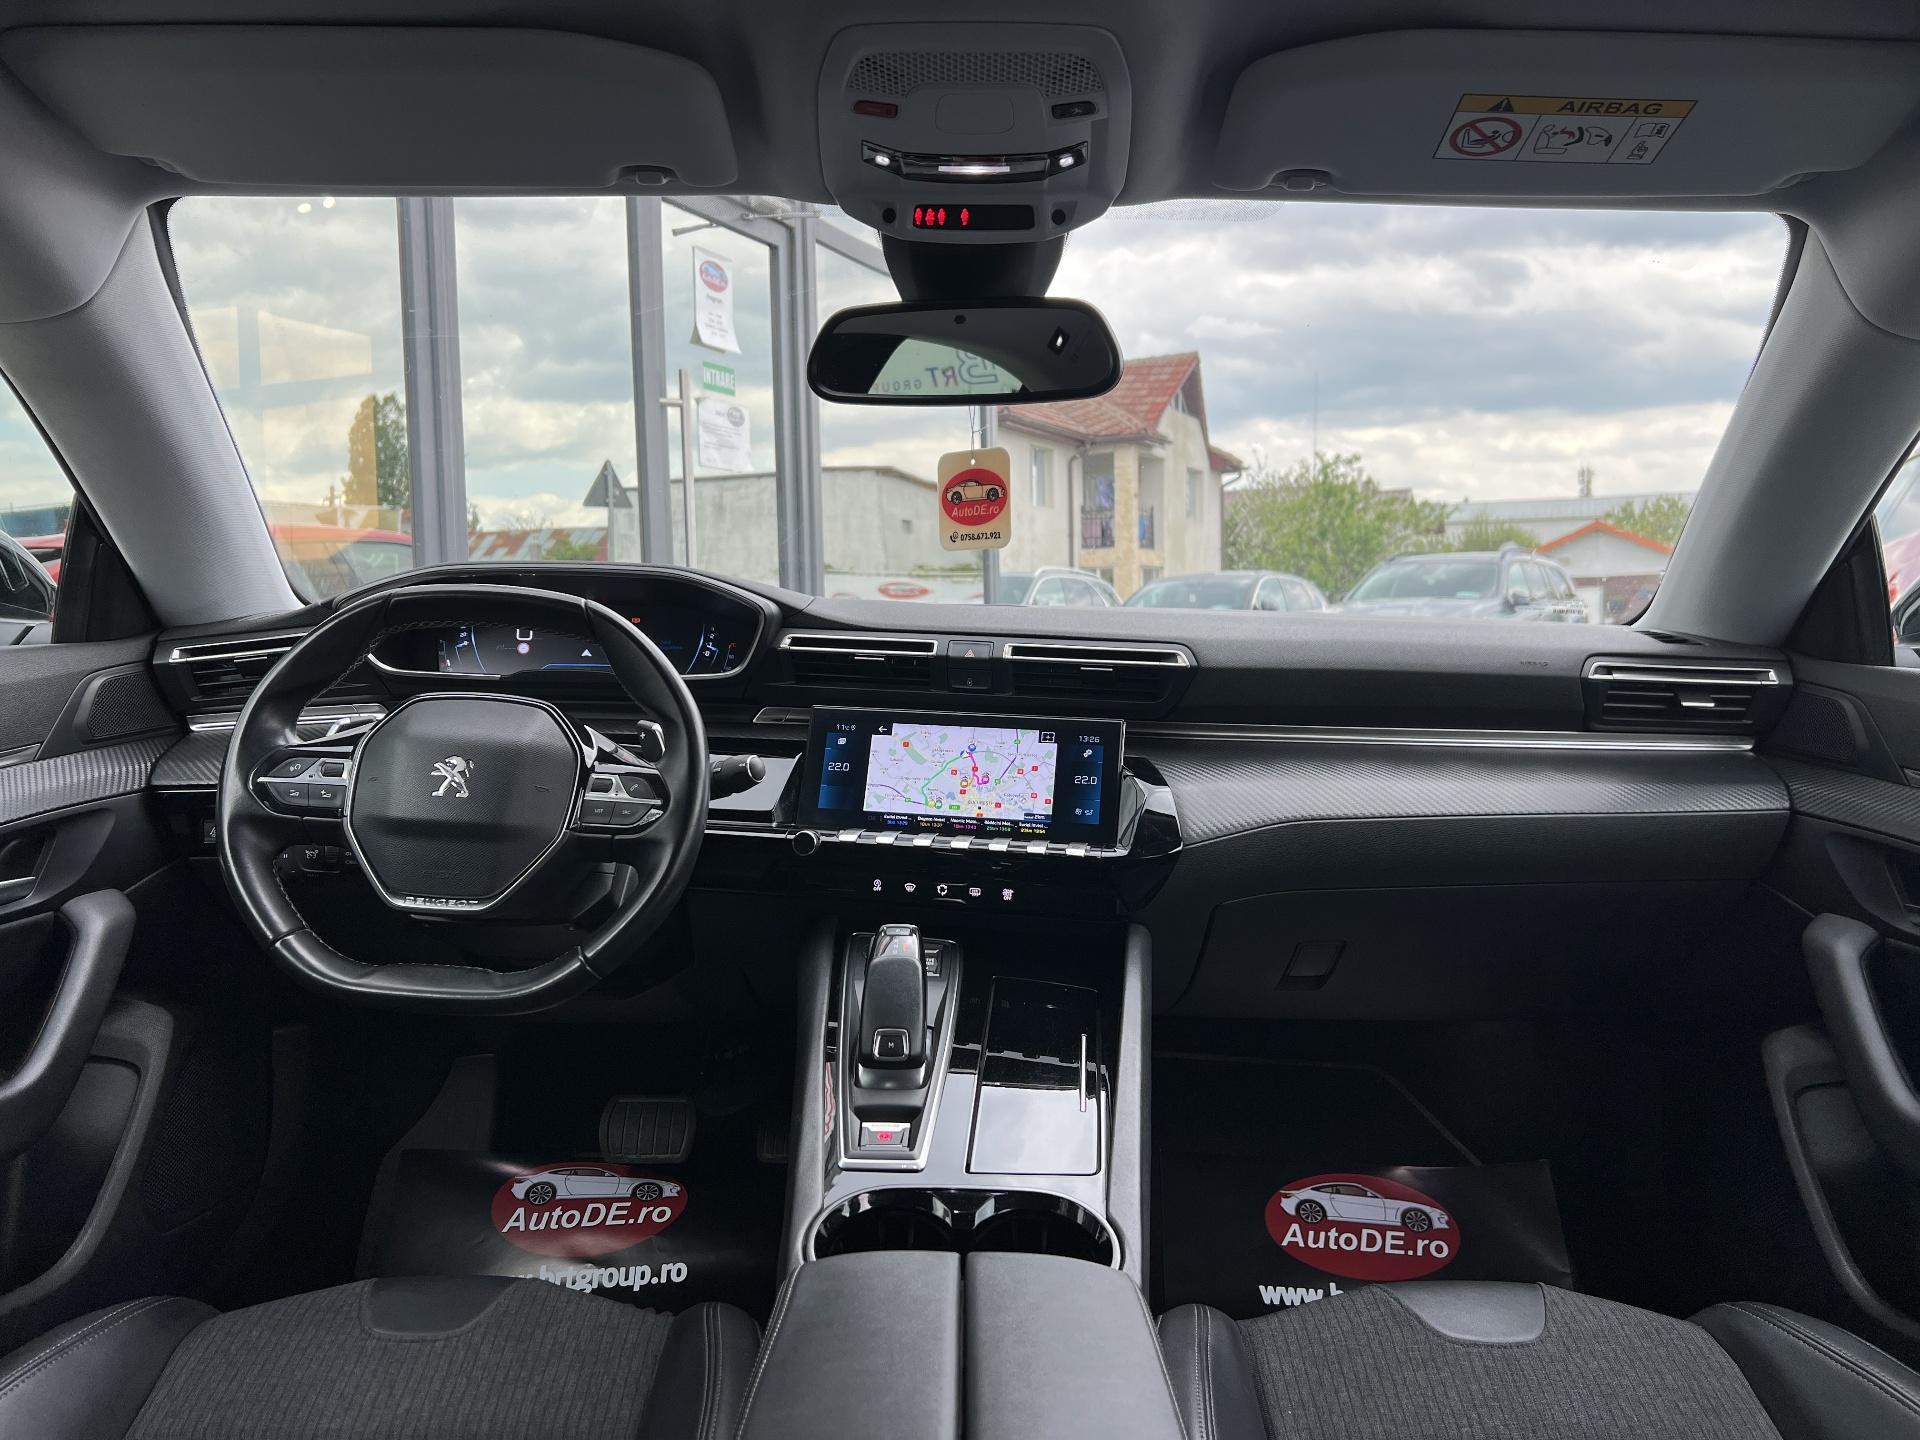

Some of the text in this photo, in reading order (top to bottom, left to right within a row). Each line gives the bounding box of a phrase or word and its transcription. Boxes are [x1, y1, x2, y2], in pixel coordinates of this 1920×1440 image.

[1556, 100, 1664, 115] AIRBAG
[703, 366, 736, 391] INTRARE
[951, 504, 1000, 518] AutoDE.ro
[828, 762, 850, 772] 22.0
[1074, 775, 1098, 785] 22.0
[501, 1201, 672, 1234] AutoDE.ro
[1281, 1222, 1449, 1259] AutoDE.ro
[518, 1262, 688, 1294] brtgroup.ro
